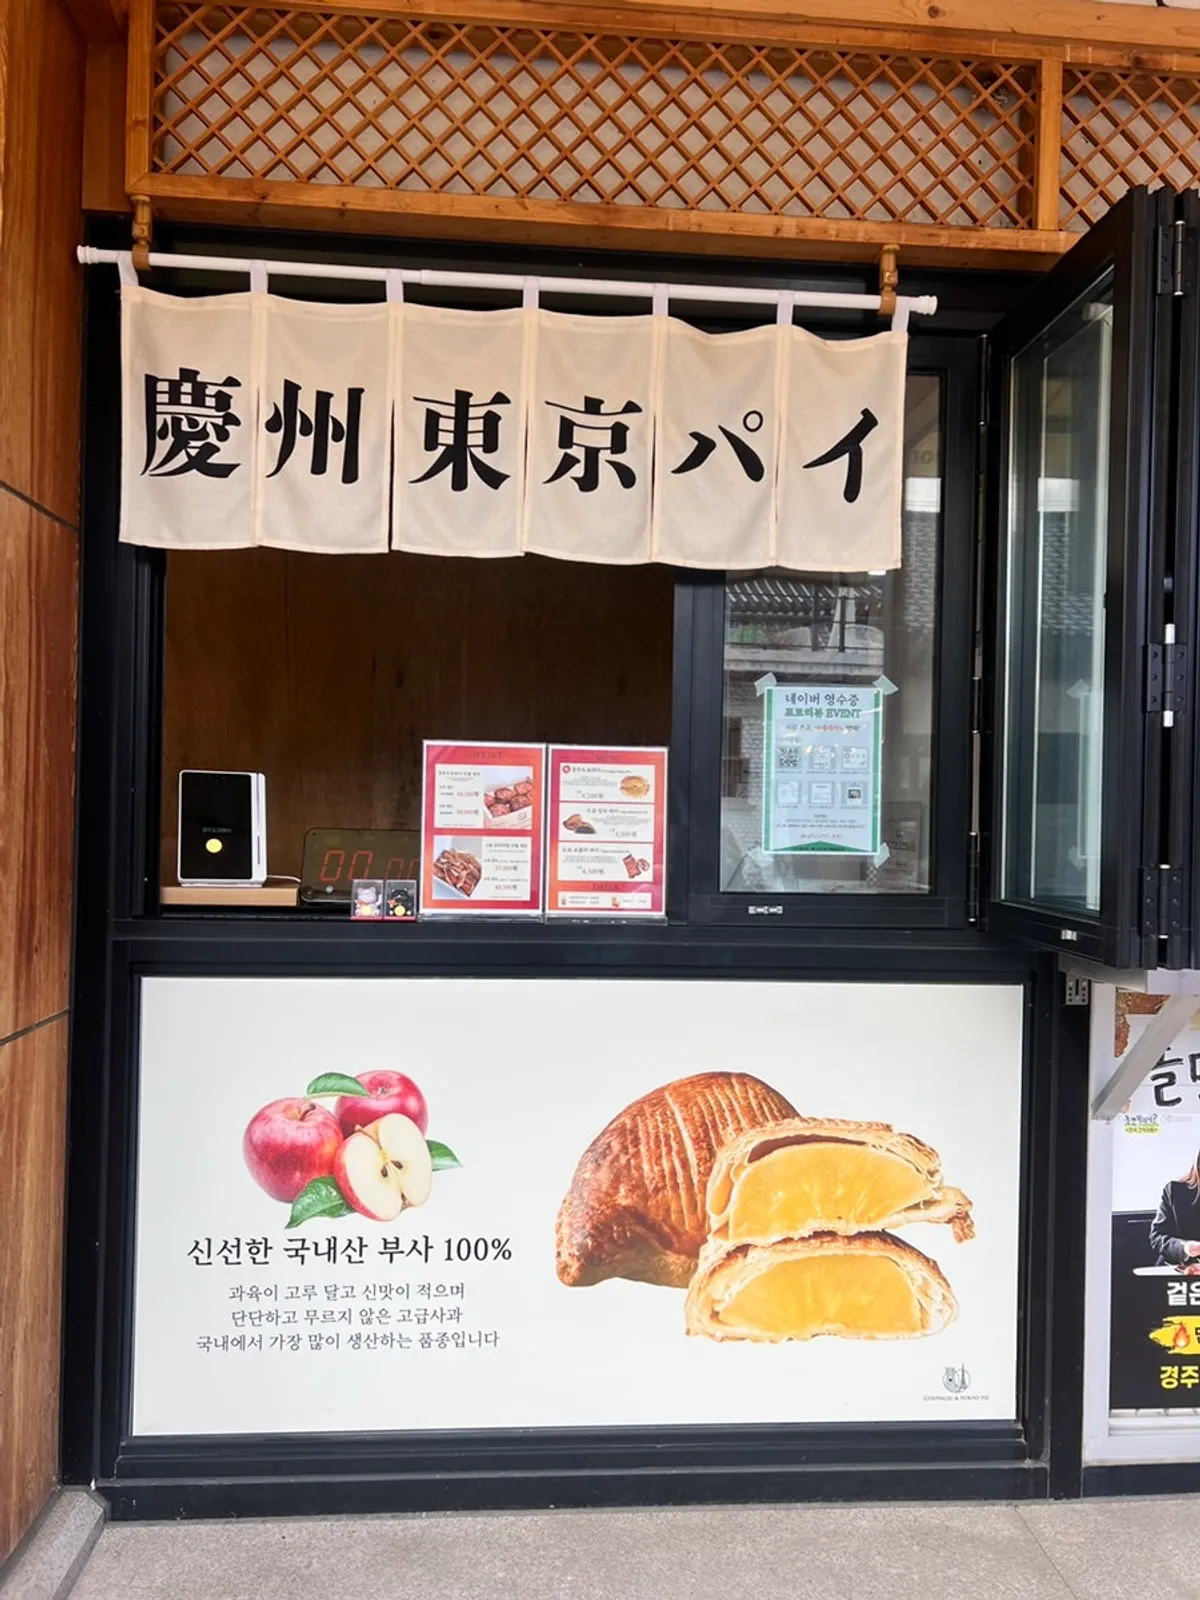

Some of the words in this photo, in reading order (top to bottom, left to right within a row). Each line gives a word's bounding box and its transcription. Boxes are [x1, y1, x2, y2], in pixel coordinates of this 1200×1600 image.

[139, 366, 879, 503] 慶州東京パイ
[785, 692, 820, 705] 네이버
[824, 693, 859, 707] 영수증
[826, 708, 862, 719] EVENT
[187, 1236, 274, 1266] 신선한
[283, 1235, 369, 1266] 국내산
[378, 1234, 434, 1265] 부사
[444, 1237, 512, 1262] 100%
[228, 1283, 278, 1302] 과육이
[284, 1284, 318, 1301] 고루
[323, 1283, 356, 1302] 달고
[362, 1283, 410, 1301] 신맛이
[416, 1282, 465, 1300] 적으며
[231, 1309, 298, 1328] 단단하고
[304, 1308, 352, 1326] 무르지
[358, 1307, 391, 1326] 않은
[397, 1306, 462, 1325] 고급사과
[196, 1334, 263, 1353] 국내에서
[269, 1333, 302, 1352] 가장
[308, 1333, 340, 1351] 많이
[347, 1332, 412, 1350] 생산하는
[418, 1330, 499, 1349] 품종입니다
[1160, 1366, 1200, 1389] 경주
